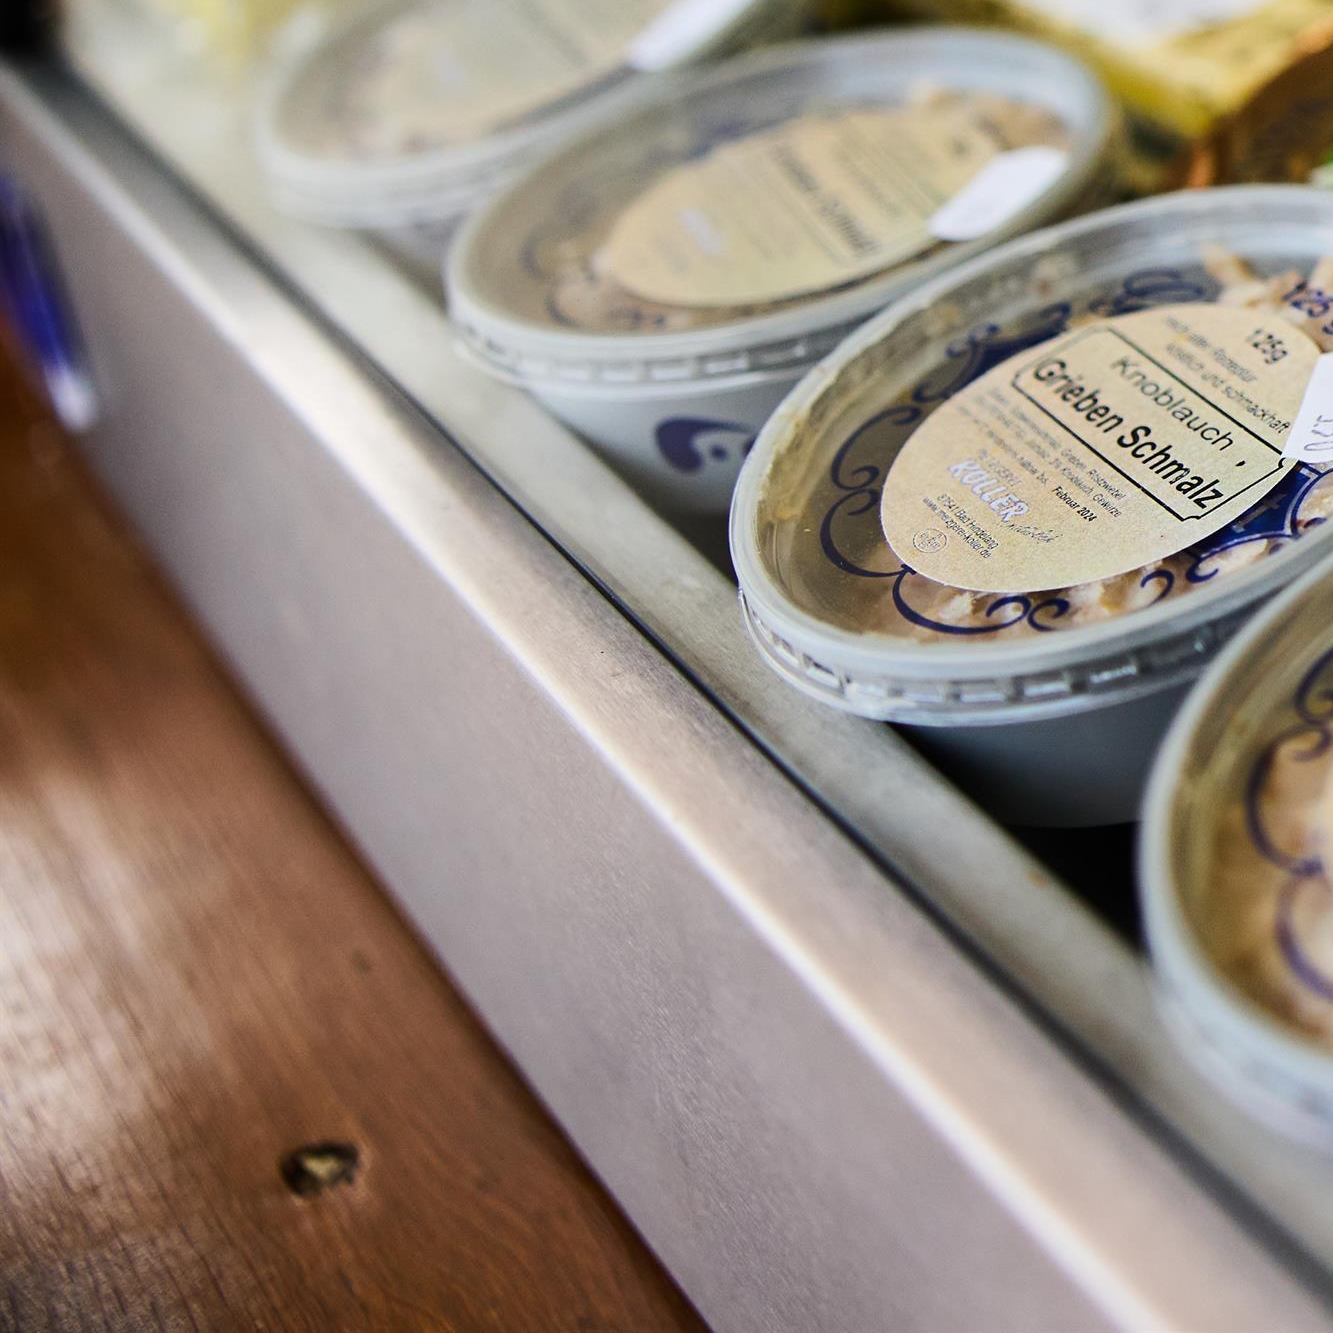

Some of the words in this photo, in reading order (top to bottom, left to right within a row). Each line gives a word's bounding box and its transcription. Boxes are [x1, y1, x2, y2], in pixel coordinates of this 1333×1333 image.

[1247, 327, 1289, 365] 125g
[1111, 355, 1235, 452] Knoblauch
[1220, 384, 1292, 434] schmackhaft
[1032, 358, 1125, 434] Grieben
[1115, 424, 1225, 510] Schmalz
[947, 458, 1030, 523] KOLLER
[1051, 485, 1080, 511] Februar
[1076, 506, 1098, 523] 2024
[953, 508, 973, 527] Bad
[967, 517, 1000, 550] Hindelang
